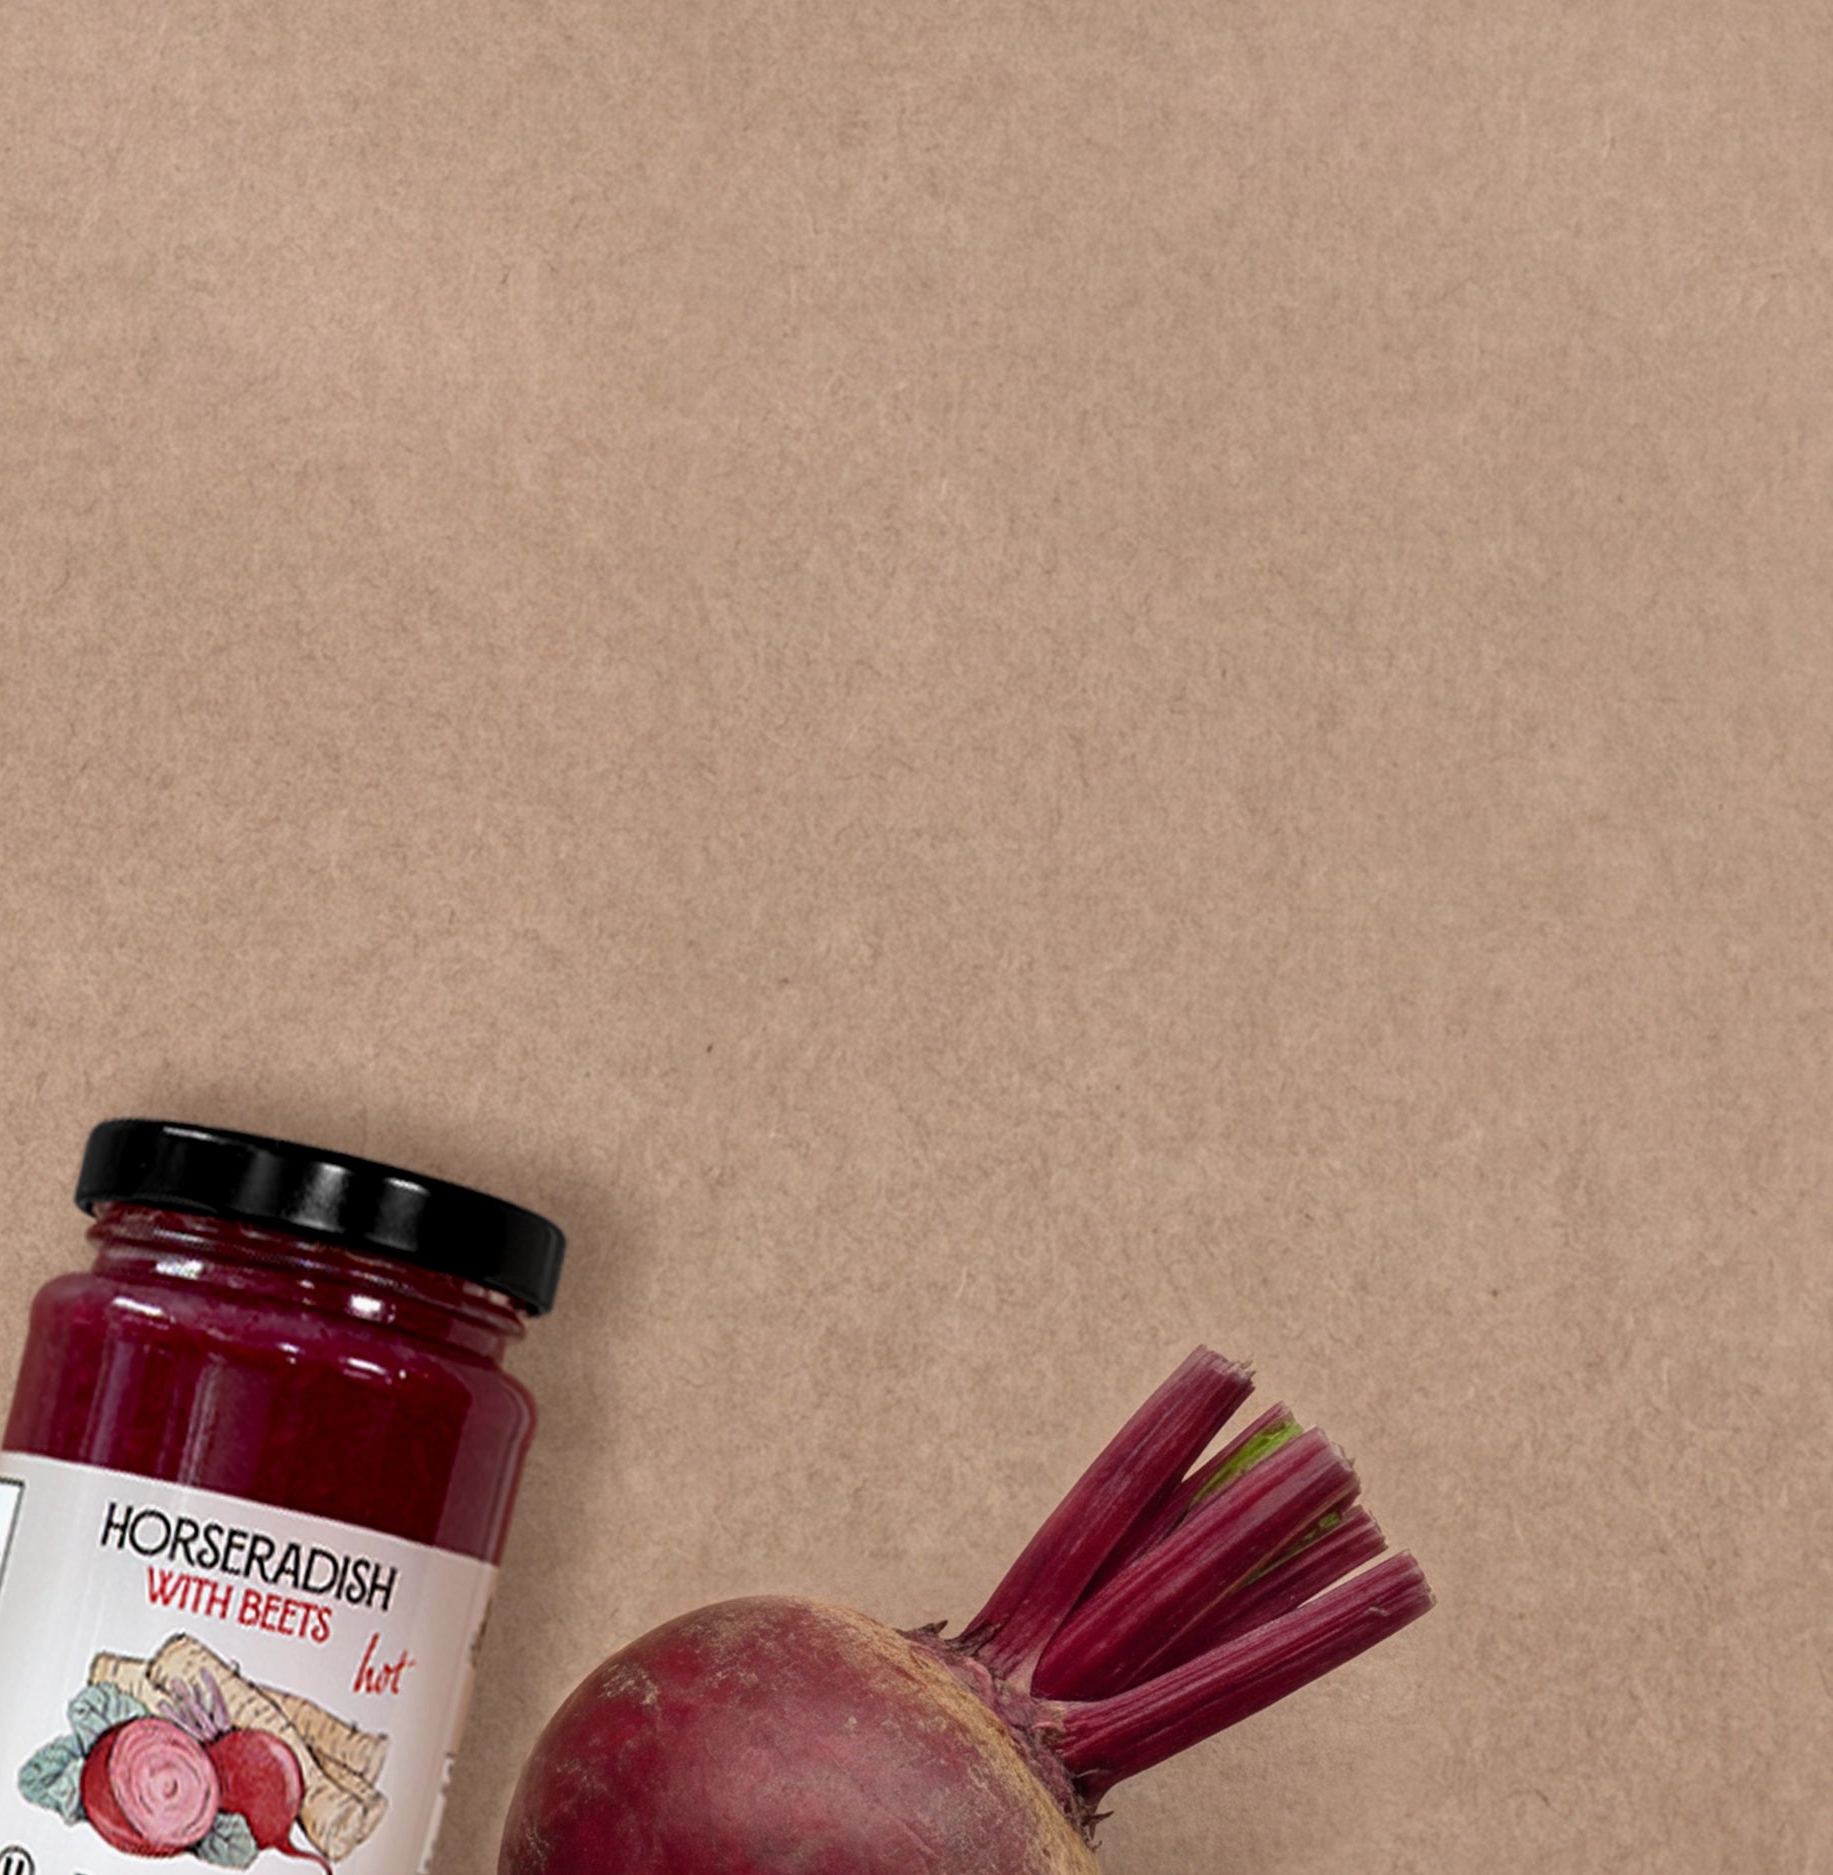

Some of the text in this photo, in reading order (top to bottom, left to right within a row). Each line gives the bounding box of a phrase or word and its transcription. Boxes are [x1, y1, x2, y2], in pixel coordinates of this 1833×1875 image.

[100, 1501, 399, 1612] HORSERADISH
[146, 1565, 333, 1643] WITH BEETS
[353, 1633, 416, 1696] hot
